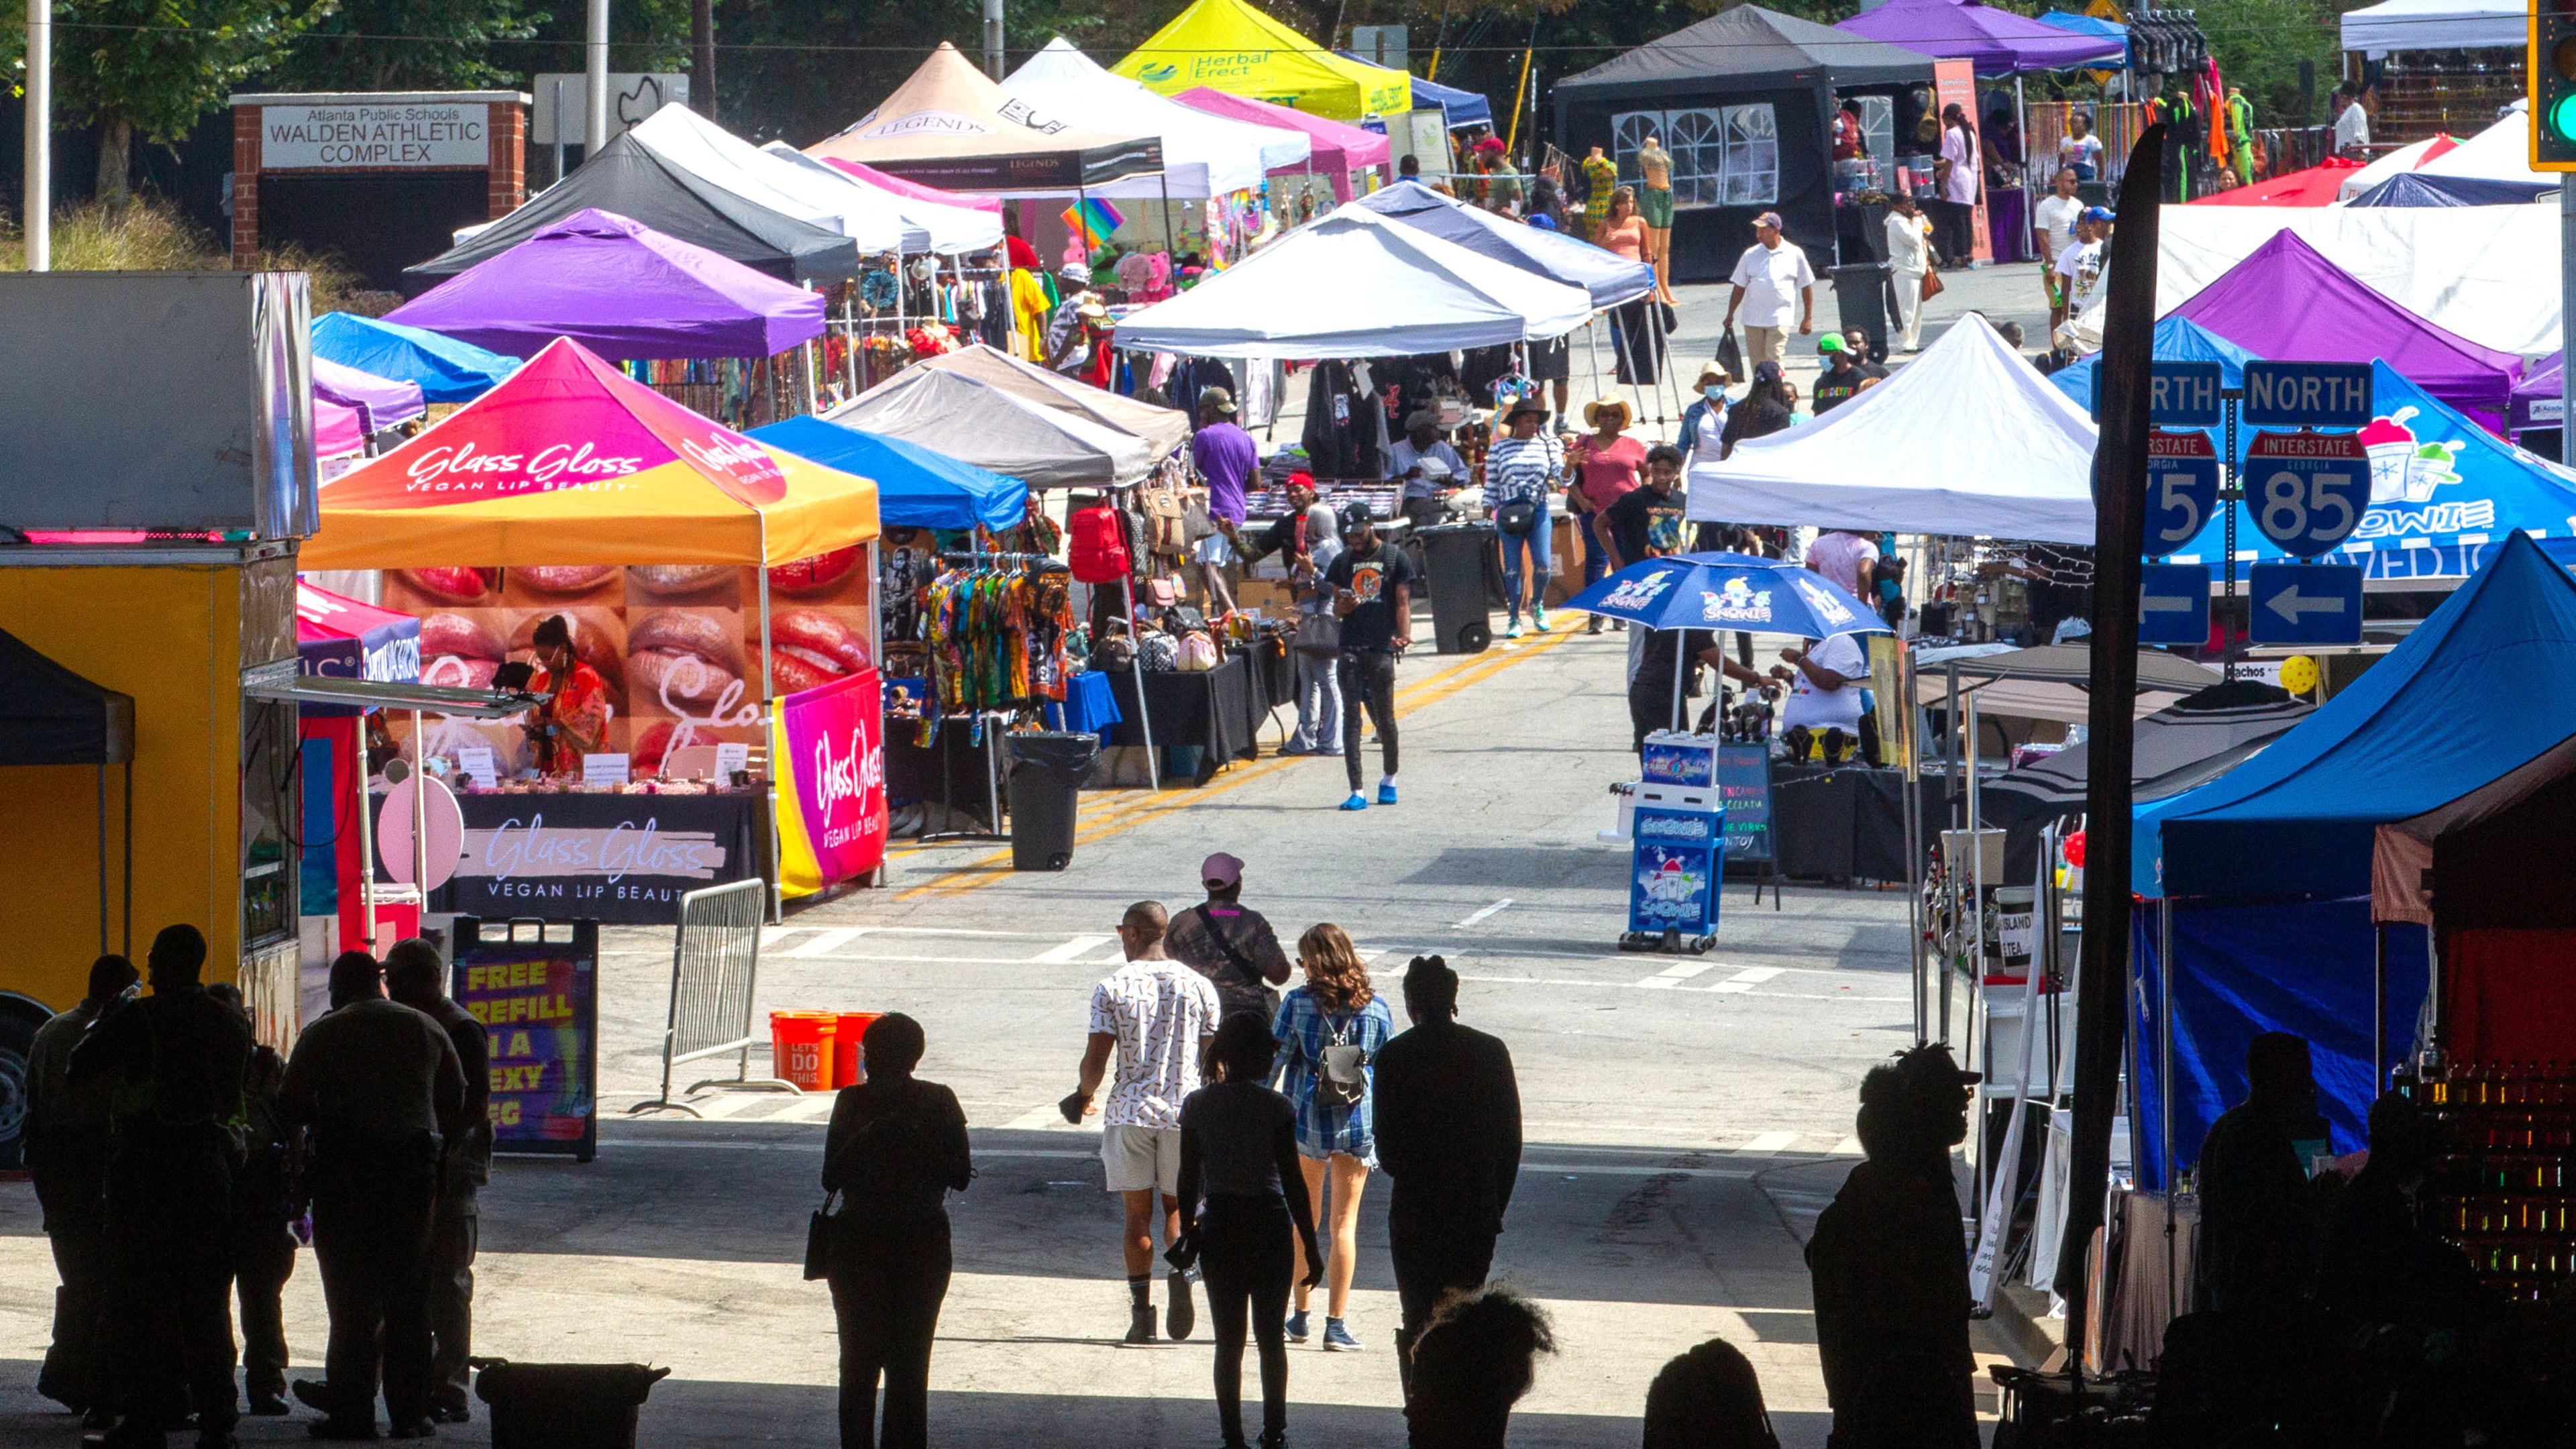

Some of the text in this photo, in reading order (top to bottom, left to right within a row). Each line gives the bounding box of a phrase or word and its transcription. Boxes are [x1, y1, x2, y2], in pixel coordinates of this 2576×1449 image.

[1197, 50, 1269, 67] Herbal
[1195, 66, 1250, 78] Erect
[308, 108, 460, 121] Atlanta Public Schools
[270, 122, 481, 143] WALDEN ATHLETIC
[877, 117, 986, 136] LEGENDS
[321, 144, 431, 162] COMPLEX
[2151, 376, 2213, 411] RTH
[2251, 372, 2365, 411] NORTH
[2149, 438, 2198, 454] RSTATE
[2264, 438, 2351, 455] INTERSTATE
[407, 442, 642, 484] Glass Gloss
[2148, 460, 2178, 470] ORGIA
[2288, 460, 2330, 470] GEORGIA
[406, 481, 628, 492] VEGAN LIP BEAUTY
[2147, 473, 2199, 541] 5
[2261, 471, 2354, 541] 85
[2356, 498, 2495, 538] OWIE
[1703, 606, 1772, 623] SNOWIE
[2235, 665, 2265, 678] achos
[824, 826, 850, 849] VEGAN
[851, 819, 862, 840] LIP
[1640, 817, 1706, 836] SNOWIE
[485, 812, 704, 884] Glass Gloss
[488, 883, 683, 902] VEGAN LIP BEAUT
[1640, 900, 1701, 918] SNOWIE
[2002, 916, 2031, 931] ISLAND
[2007, 941, 2023, 956] TEA
[468, 961, 547, 991] FREE
[468, 994, 573, 1024] REFILL
[508, 1031, 532, 1057] A
[791, 1042, 819, 1052] LET'S
[791, 1053, 818, 1071] DO
[489, 1065, 543, 1092] EXY
[791, 1072, 820, 1083] THIS.
[488, 1101, 521, 1126] EG
